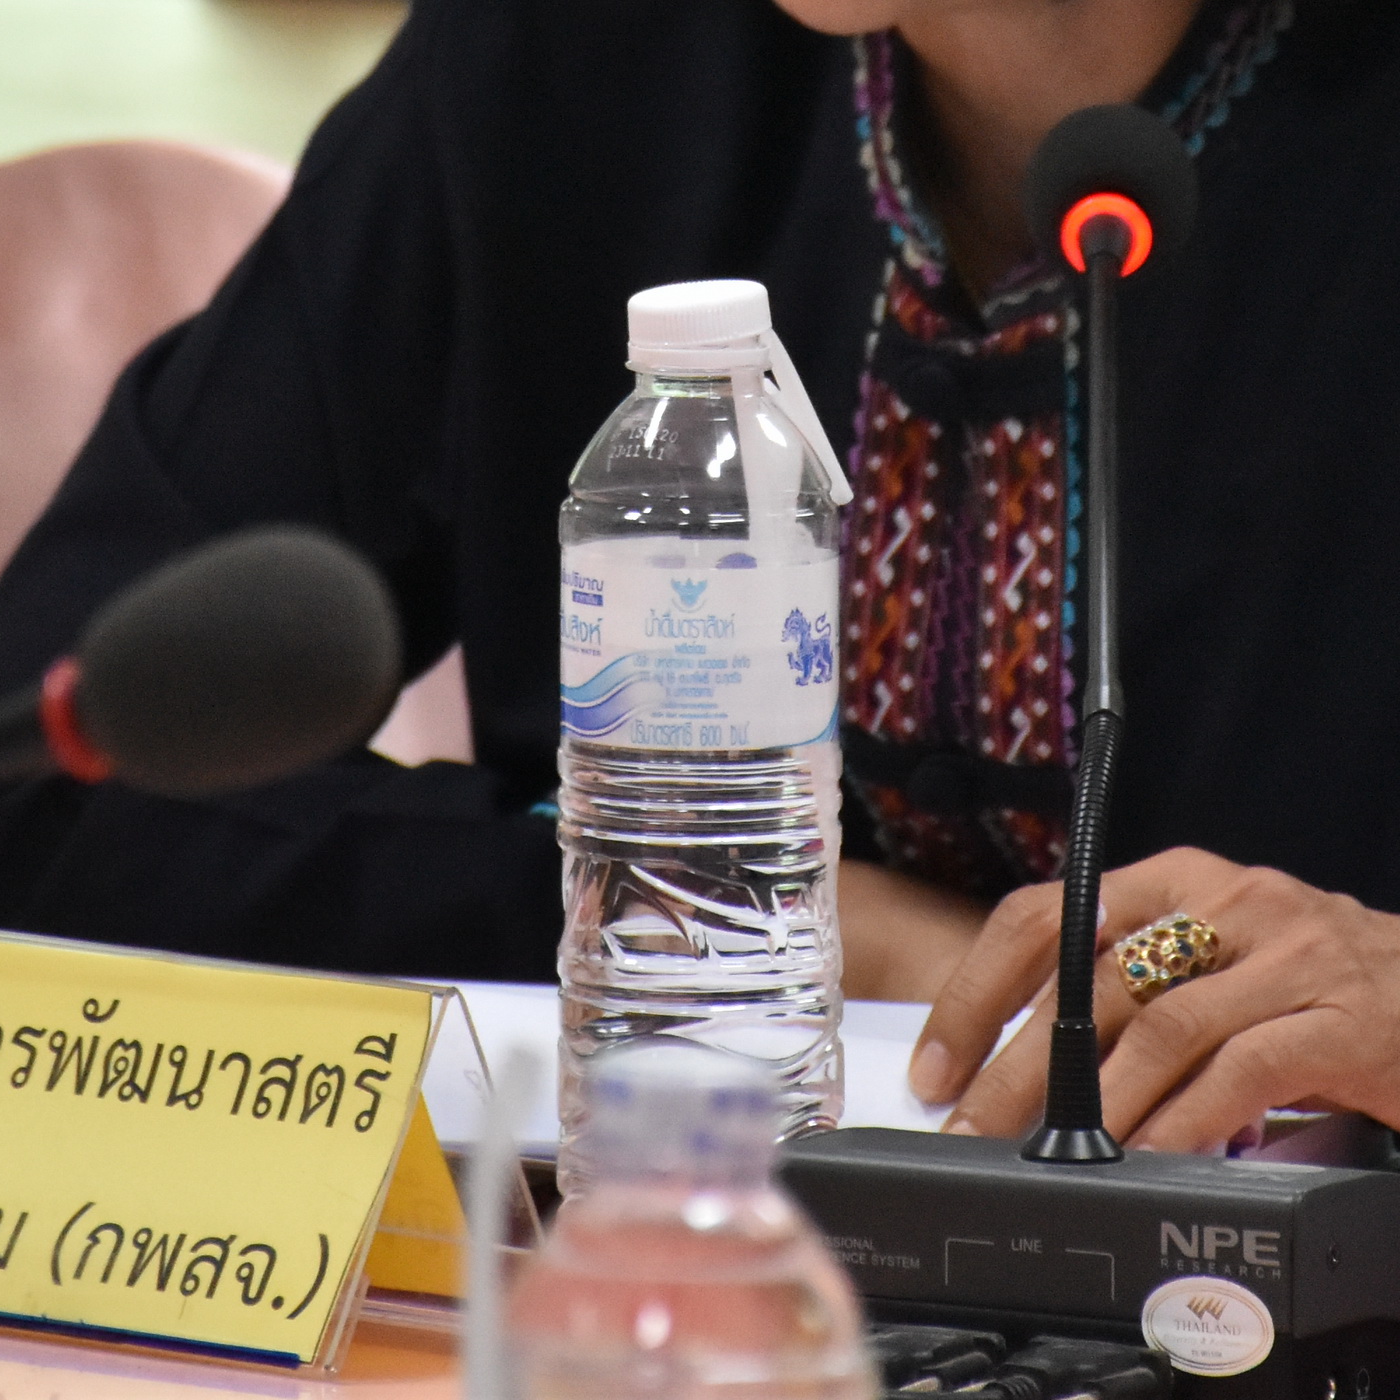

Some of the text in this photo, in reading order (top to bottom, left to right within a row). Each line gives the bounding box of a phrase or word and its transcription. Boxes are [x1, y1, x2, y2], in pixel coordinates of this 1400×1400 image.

[699, 725, 722, 747] 600
[1010, 1237, 1044, 1254] LINE
[1160, 1220, 1282, 1267] NPE
[50, 1201, 331, 1321] (กพสจ.)
[870, 1253, 921, 1270] SYSTEM
[1160, 1257, 1282, 1281] RESEARCH
[1174, 1319, 1243, 1337] THAILAND
